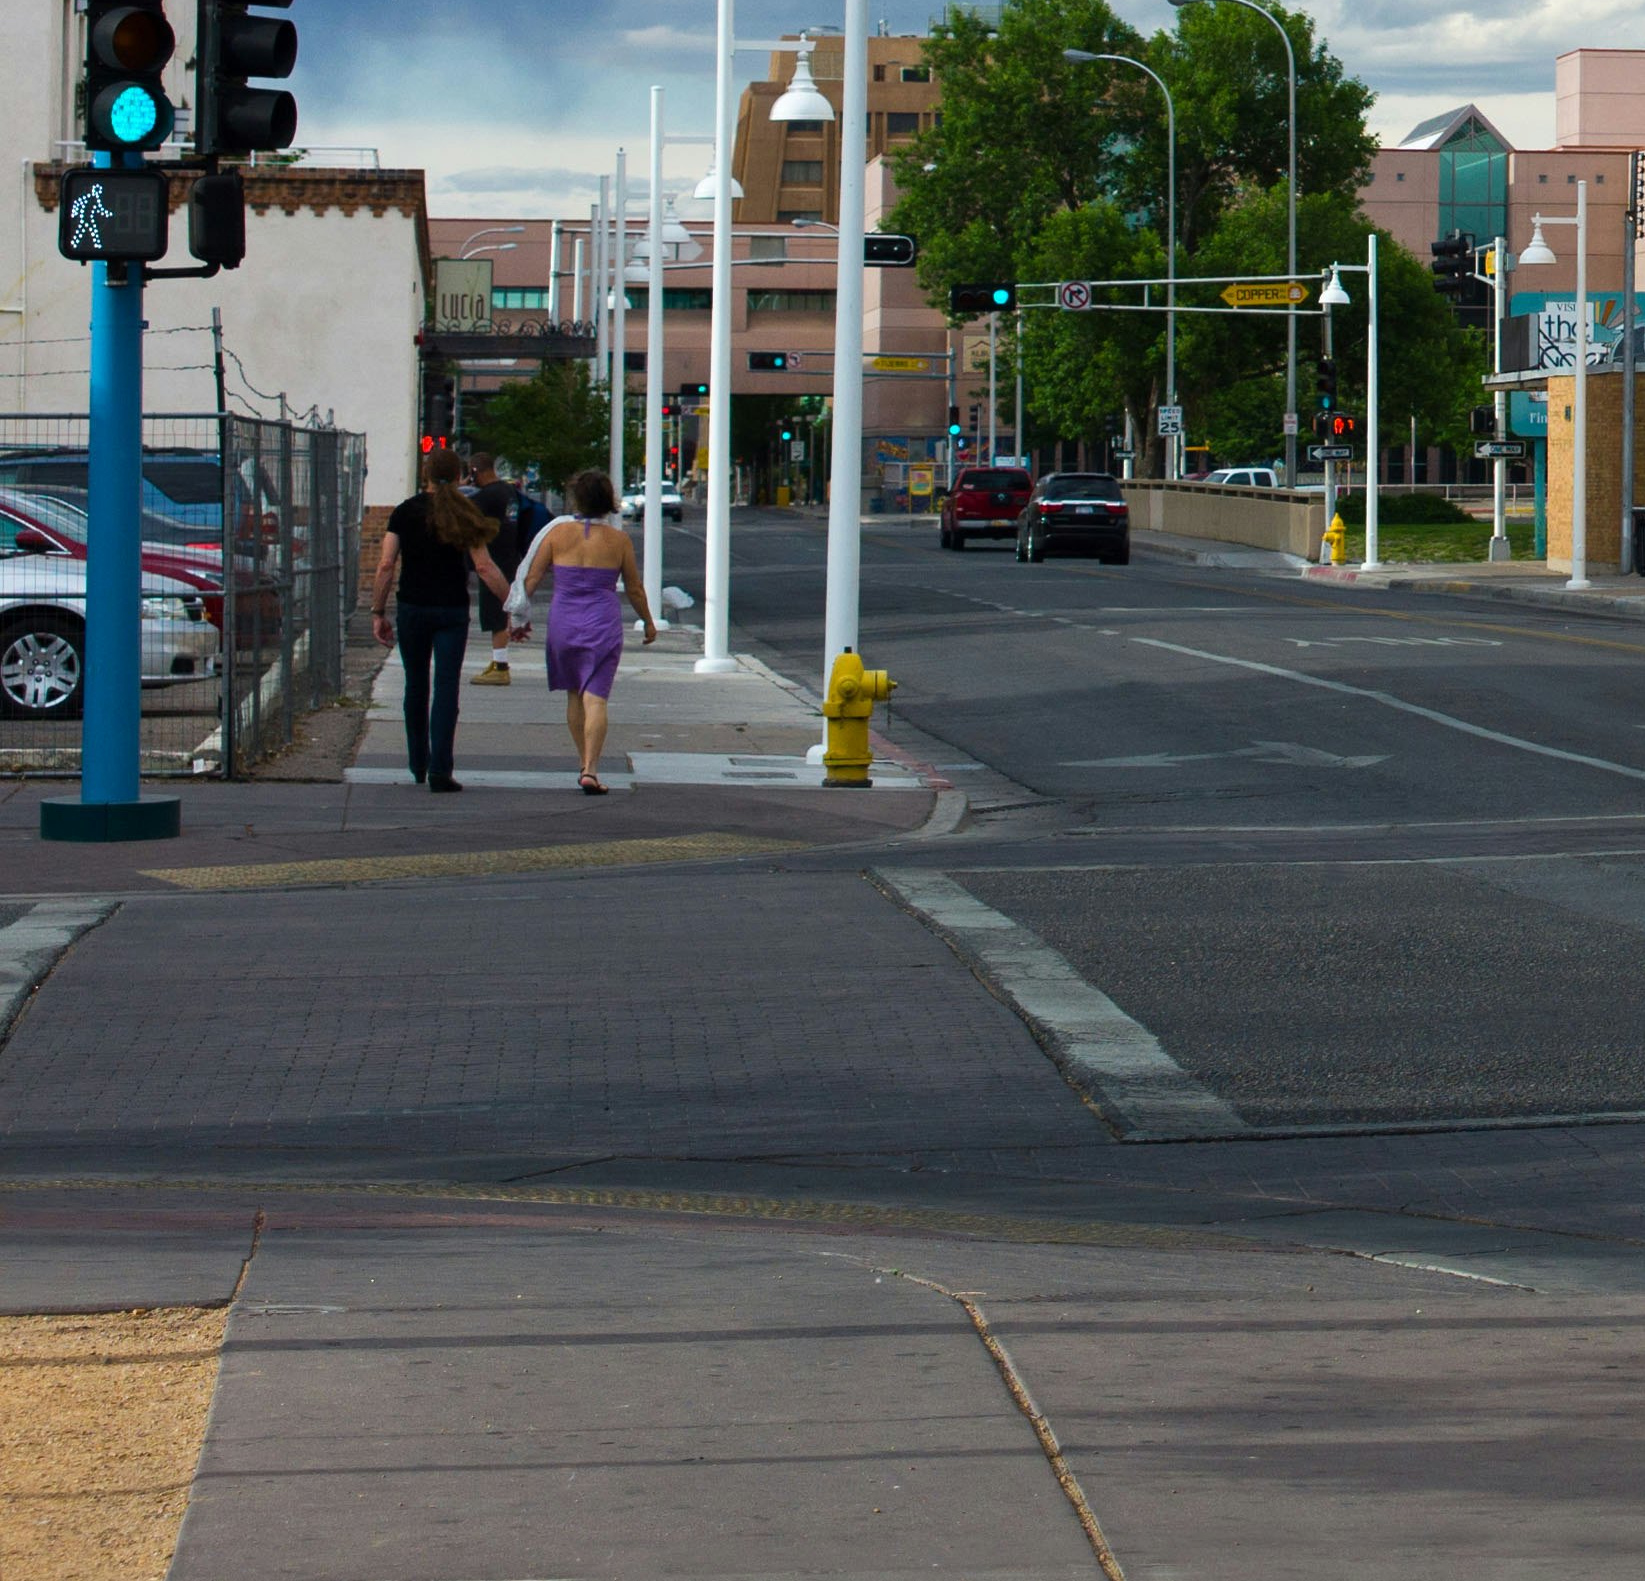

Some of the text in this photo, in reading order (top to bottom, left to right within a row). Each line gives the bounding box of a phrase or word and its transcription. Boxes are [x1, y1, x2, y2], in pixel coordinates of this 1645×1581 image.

[1236, 288, 1280, 301] COPPER
[1556, 303, 1577, 312] VISI
[1160, 422, 1180, 433] 25
